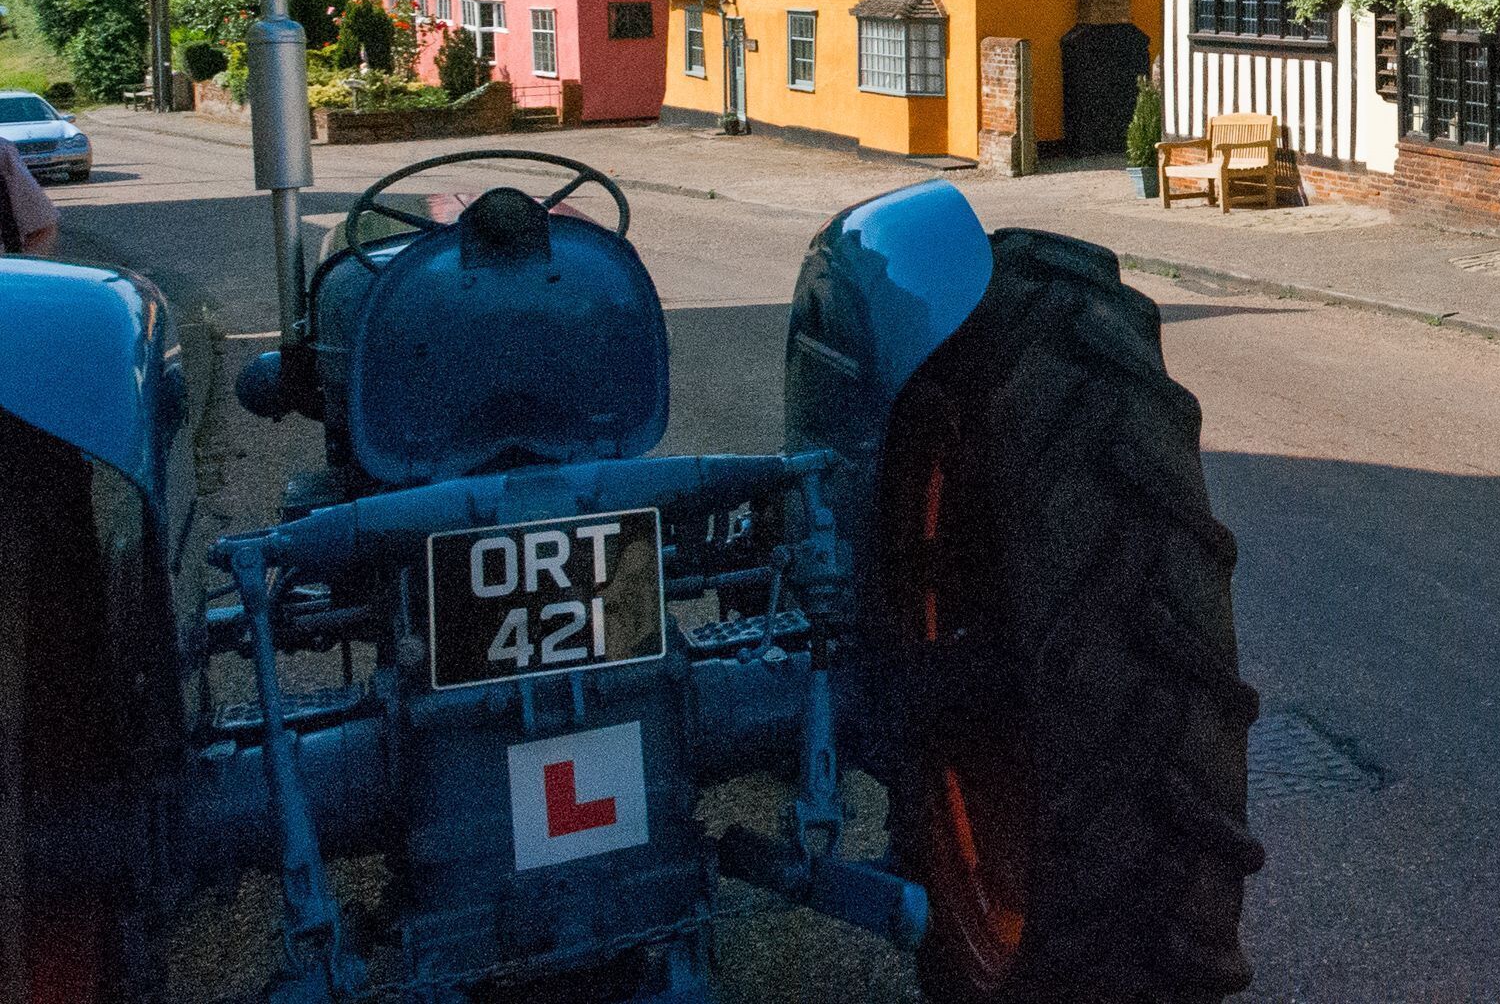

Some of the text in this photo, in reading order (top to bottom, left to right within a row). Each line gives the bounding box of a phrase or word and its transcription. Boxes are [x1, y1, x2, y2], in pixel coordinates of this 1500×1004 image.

[470, 523, 620, 597] ORT
[487, 597, 606, 667] 421
[544, 760, 617, 838] L
